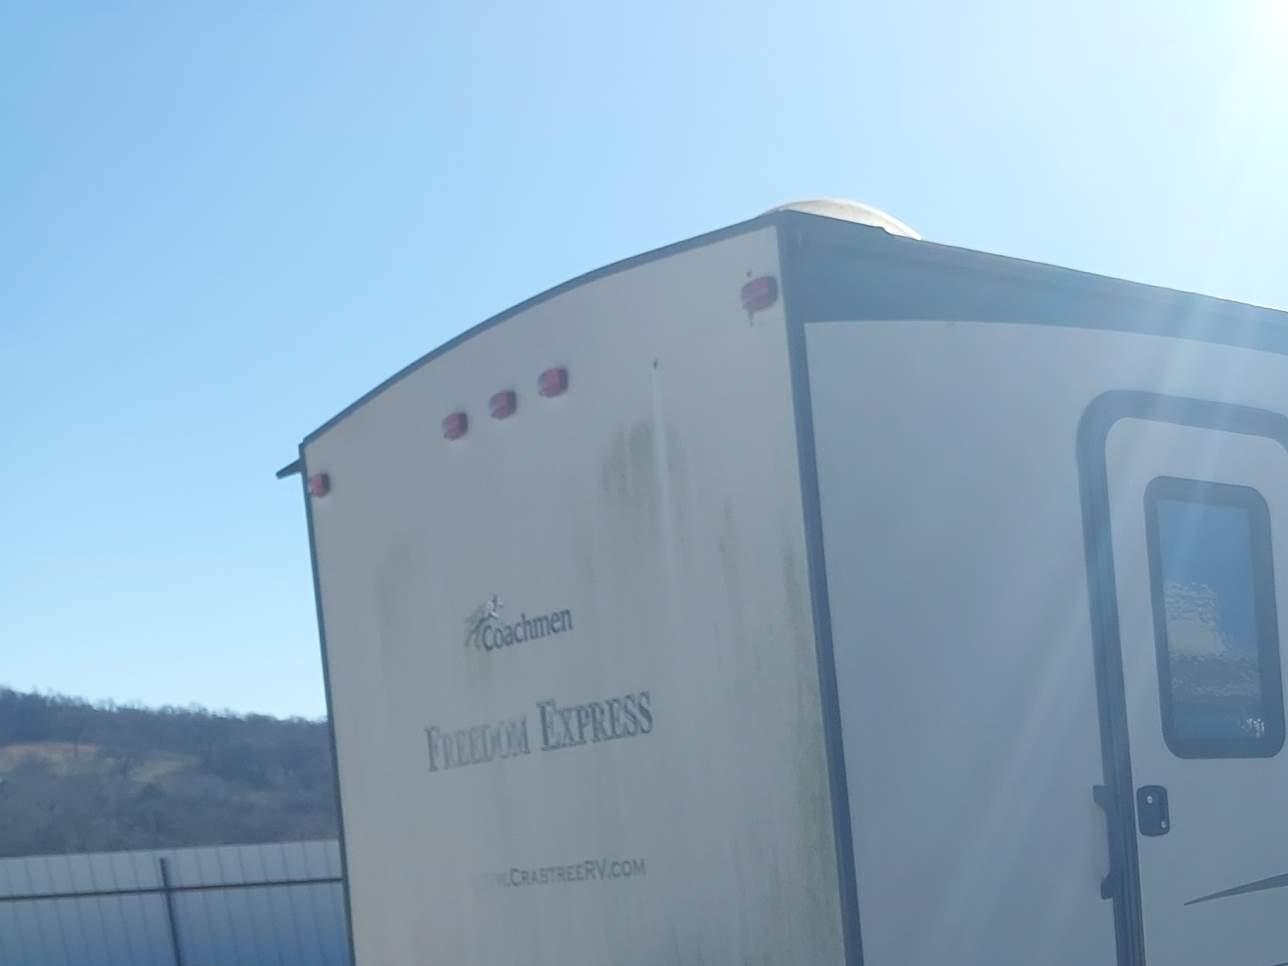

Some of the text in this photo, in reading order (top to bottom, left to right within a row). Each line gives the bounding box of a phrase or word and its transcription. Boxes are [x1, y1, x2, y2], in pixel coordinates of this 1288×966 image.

[481, 608, 574, 652] Coachmen
[424, 691, 654, 773] FREEDOM EXPRESS
